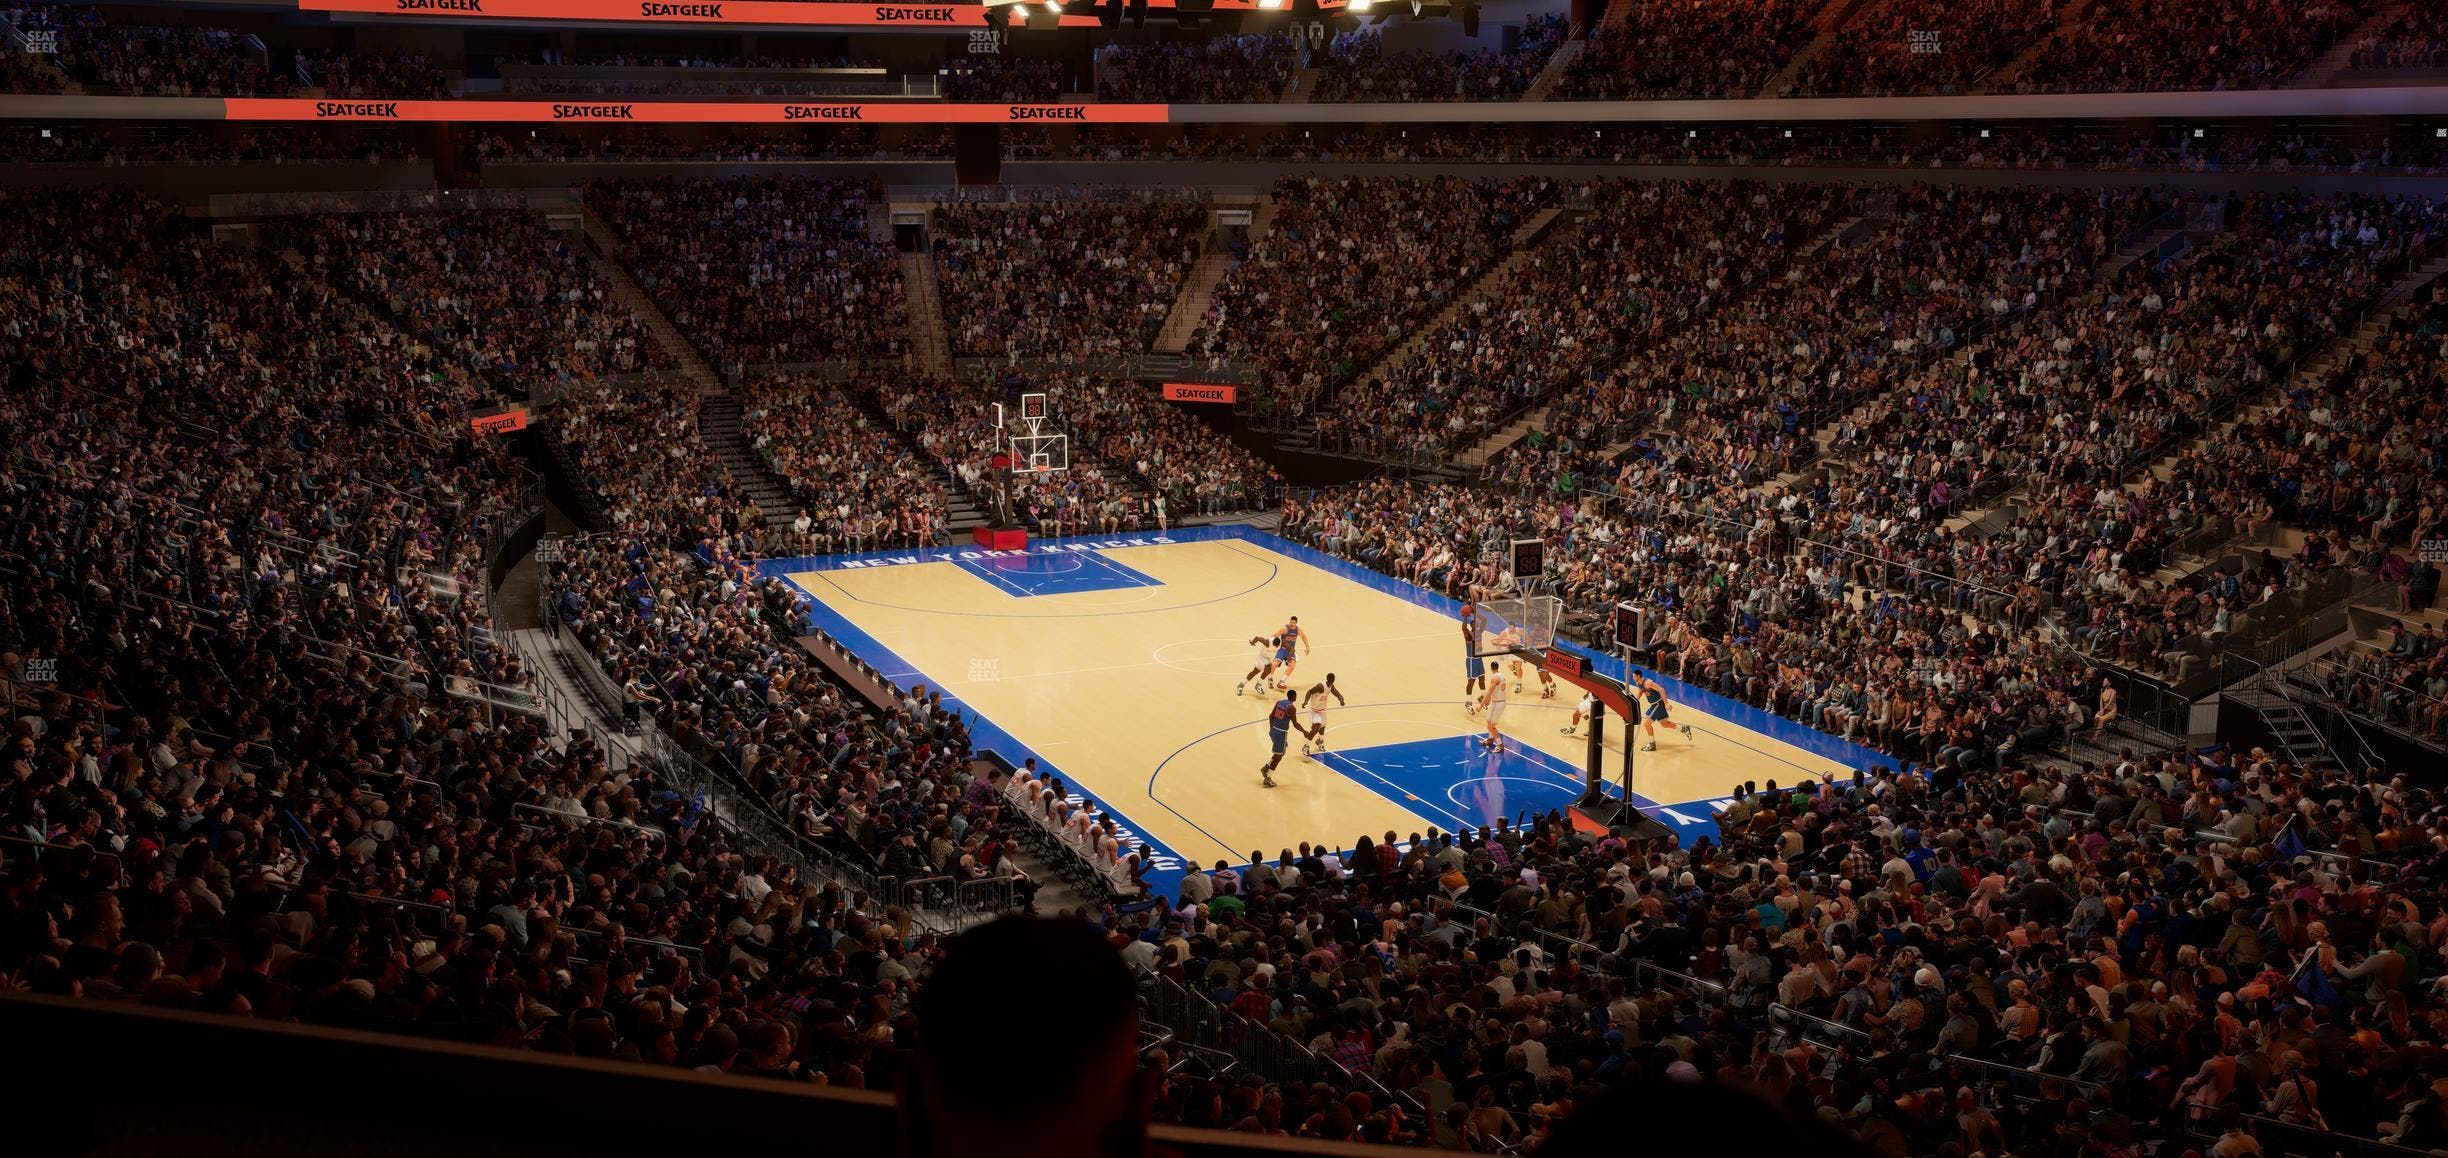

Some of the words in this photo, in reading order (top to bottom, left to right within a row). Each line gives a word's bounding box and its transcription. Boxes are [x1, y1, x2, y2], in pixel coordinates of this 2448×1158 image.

[397, 0, 483, 12] SEATGEEK
[641, 2, 723, 18] SEATGEEK
[876, 7, 955, 22] SEATGEEK
[315, 102, 399, 118] SEATGEEK
[553, 104, 633, 119] SEATGEEK
[784, 105, 862, 120] SEATGEEK
[1009, 106, 1086, 120] SEATGEEK
[1176, 388, 1224, 400] SEATGEEK
[480, 416, 517, 433] SEATGEEK
[841, 556, 918, 568] NEW
[1040, 537, 1177, 552] KNICKS
[1550, 653, 1576, 672] SEATGEEK
